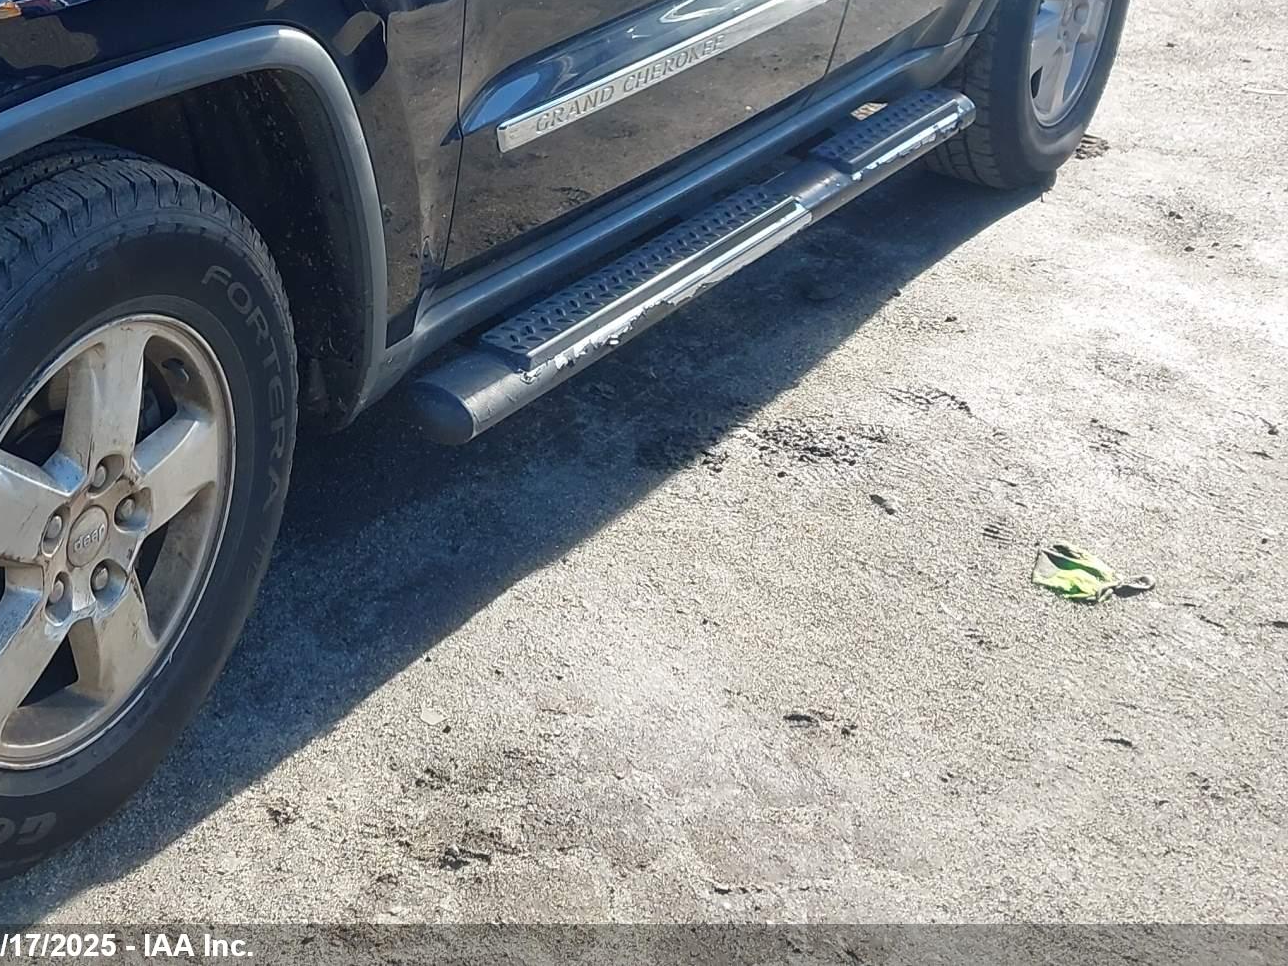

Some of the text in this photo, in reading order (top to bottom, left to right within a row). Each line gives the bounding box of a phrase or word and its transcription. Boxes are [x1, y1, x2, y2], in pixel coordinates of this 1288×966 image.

[536, 34, 728, 133] GRAND CHEROKEE
[201, 265, 286, 512] FORTERA
